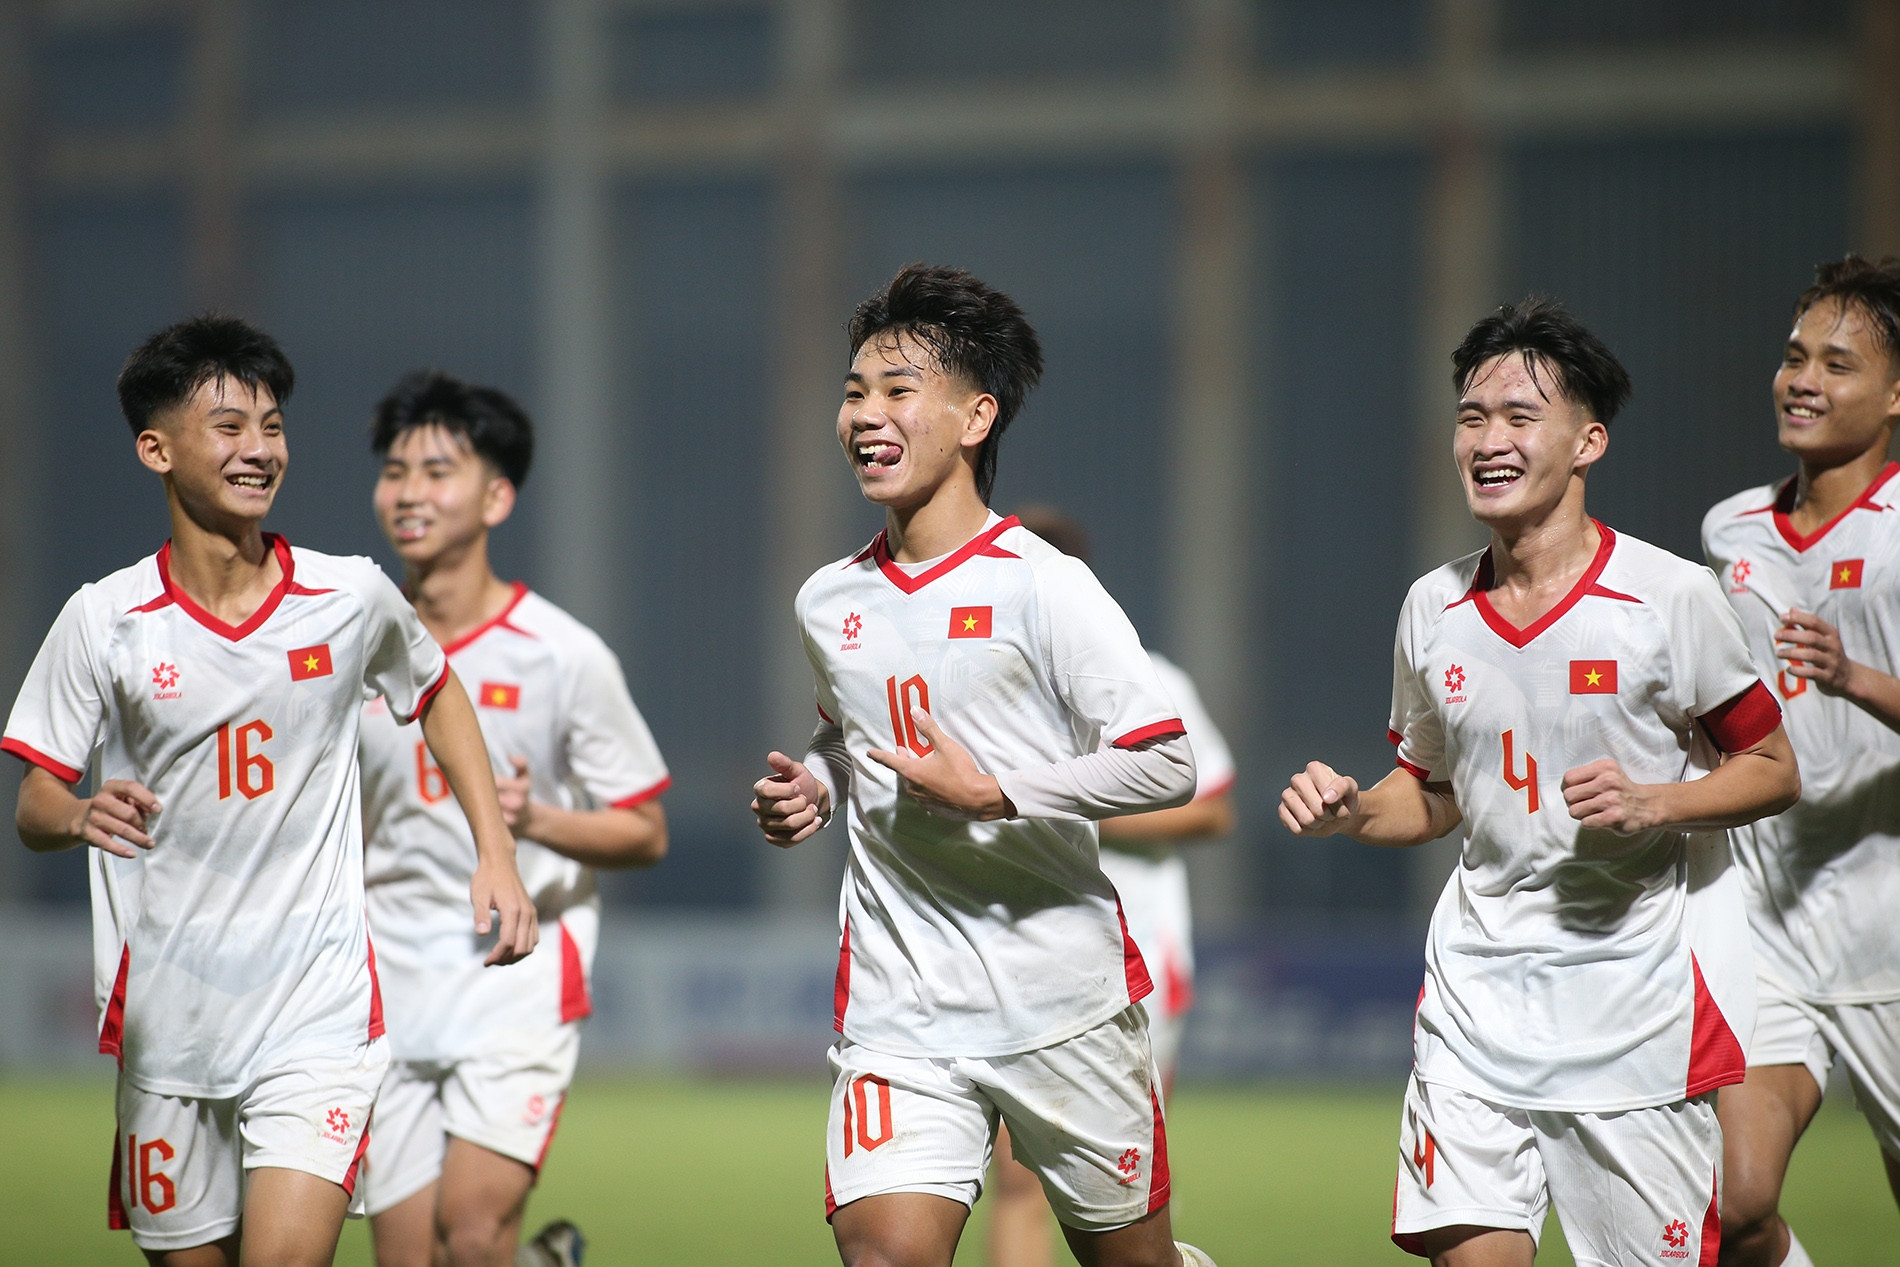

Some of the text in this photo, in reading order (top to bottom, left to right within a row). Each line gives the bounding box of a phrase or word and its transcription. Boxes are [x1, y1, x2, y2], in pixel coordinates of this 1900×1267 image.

[885, 673, 936, 759] 10
[217, 719, 275, 801] 16
[416, 741, 450, 804] 6
[1501, 729, 1539, 814] 4
[842, 1073, 894, 1158] 10
[1413, 1110, 1436, 1191] 4
[128, 1134, 176, 1215] 16
